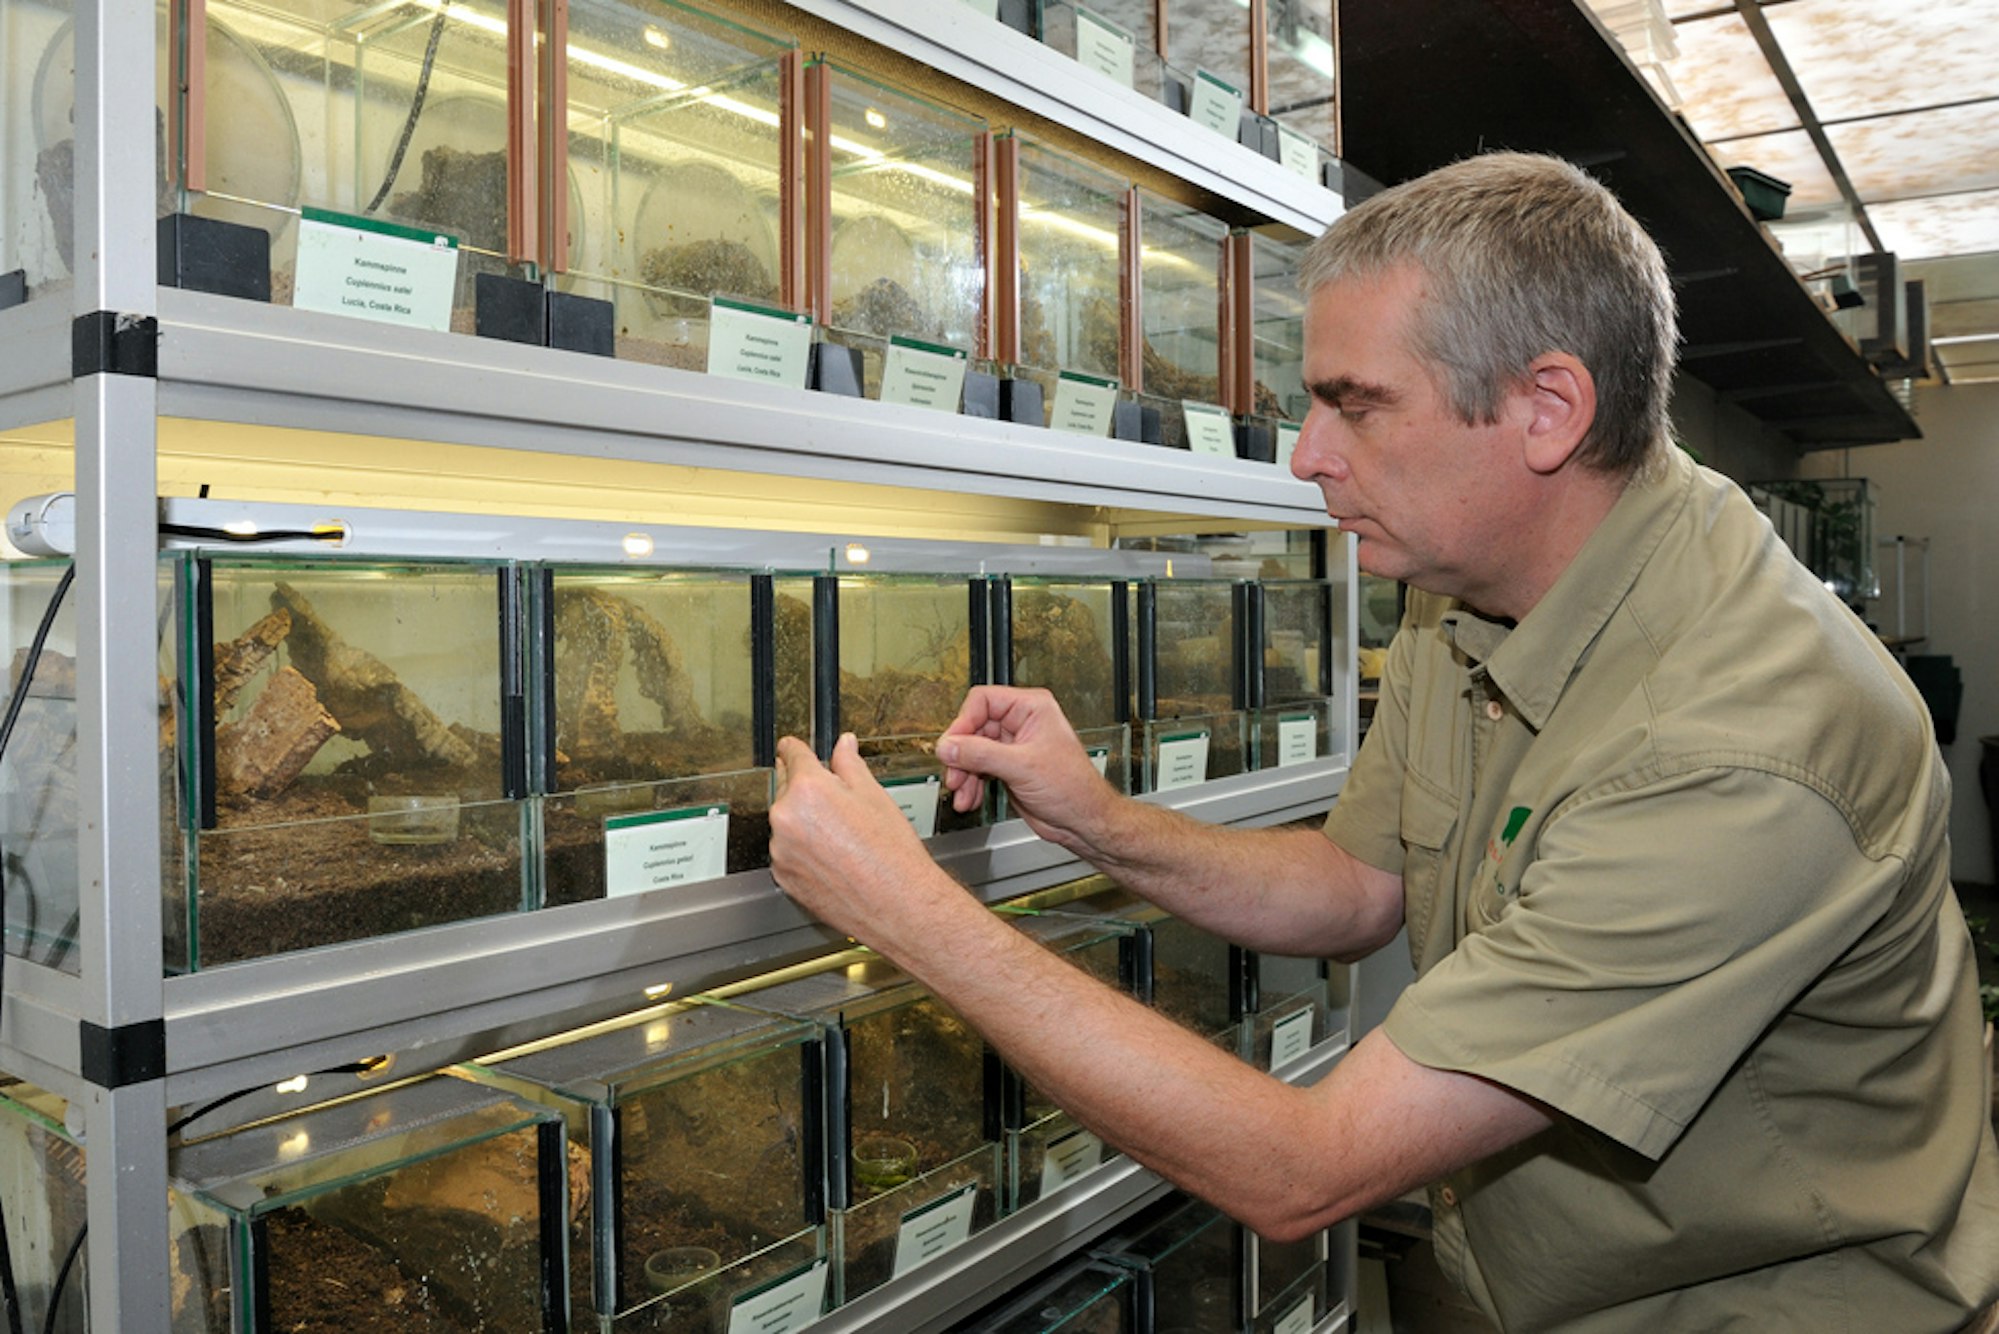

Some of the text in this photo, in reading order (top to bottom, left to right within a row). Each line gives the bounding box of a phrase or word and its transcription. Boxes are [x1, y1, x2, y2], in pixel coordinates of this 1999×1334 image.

[355, 258, 407, 273] Kammspinne
[346, 277, 391, 291] Cupiennius
[369, 299, 392, 312] Costa
[393, 304, 411, 315] Rica
[653, 872, 684, 884] Costa Rica
